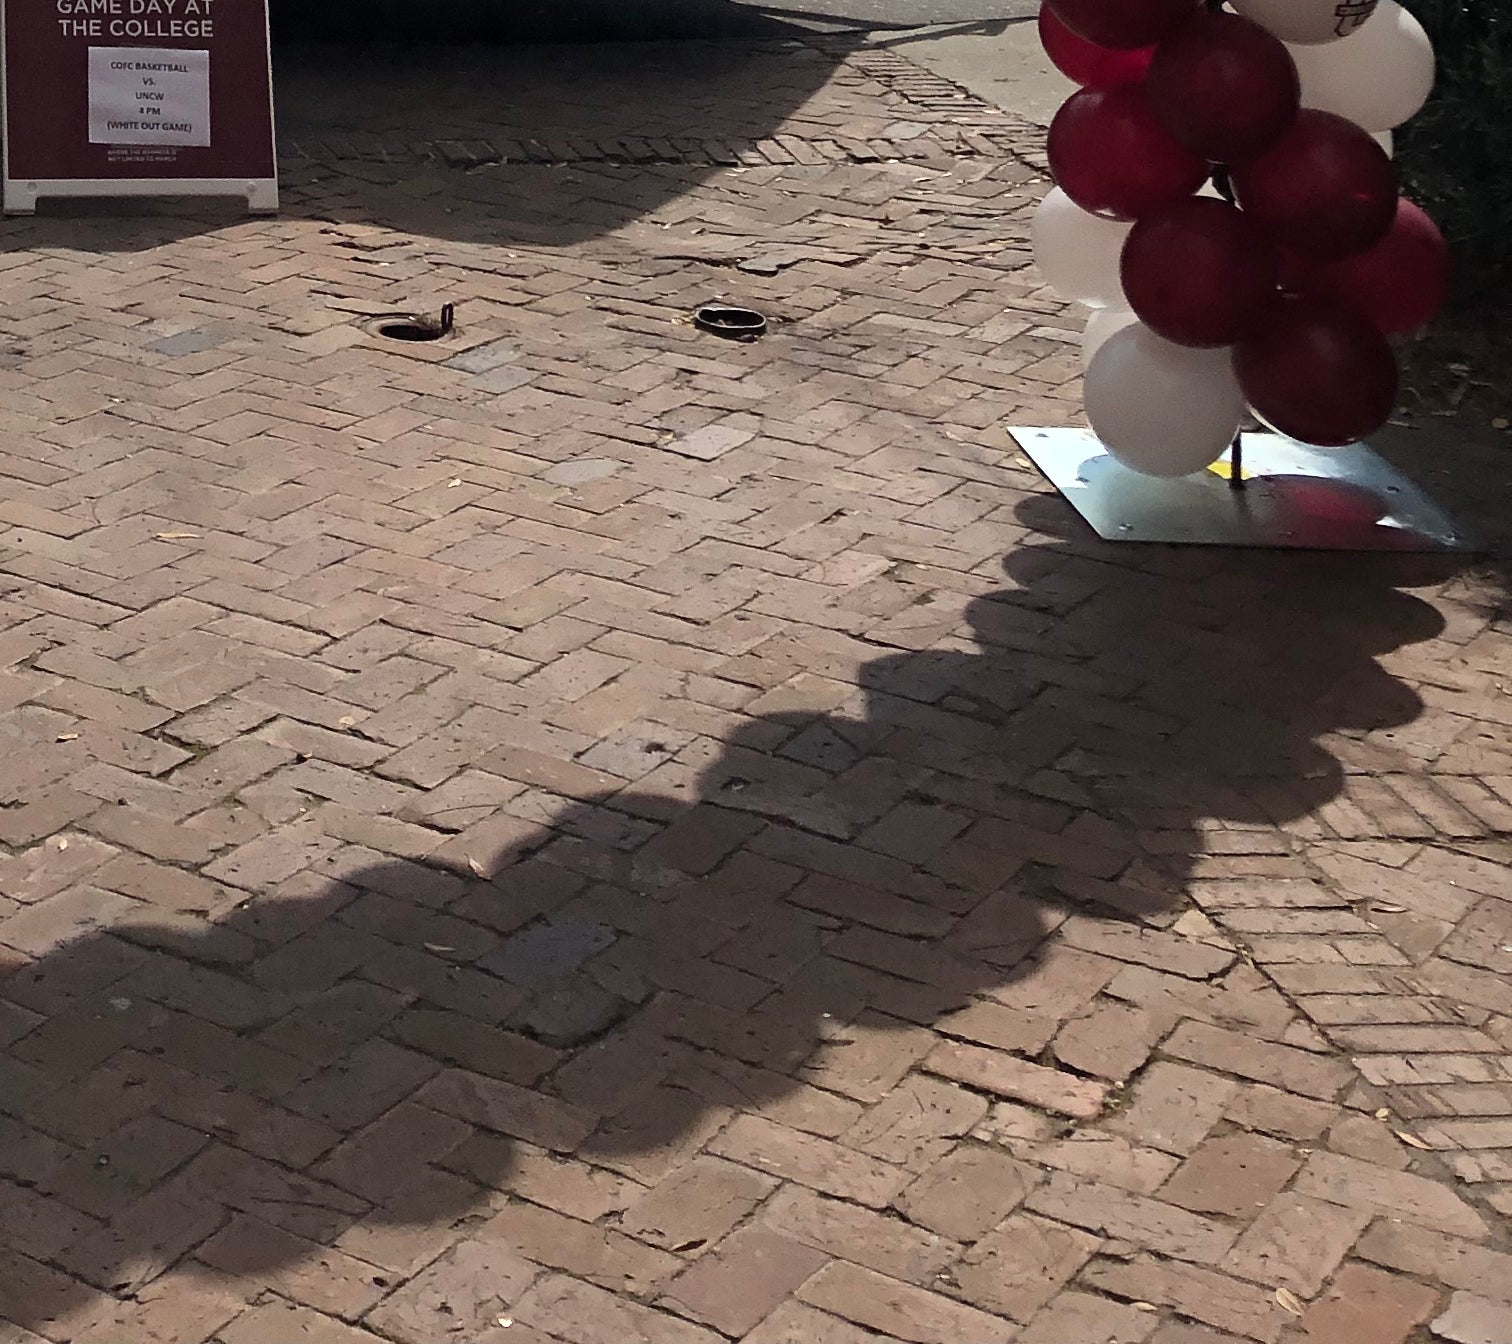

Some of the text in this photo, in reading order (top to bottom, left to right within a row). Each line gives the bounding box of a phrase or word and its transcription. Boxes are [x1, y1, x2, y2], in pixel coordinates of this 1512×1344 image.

[58, 18, 215, 37] THE COLLEGE
[135, 62, 189, 73] BASKETBALL
[142, 77, 157, 86] VS.
[135, 91, 165, 101] UNCW
[146, 107, 161, 116] PM
[107, 121, 193, 133] (WHITE OUT GAME)
